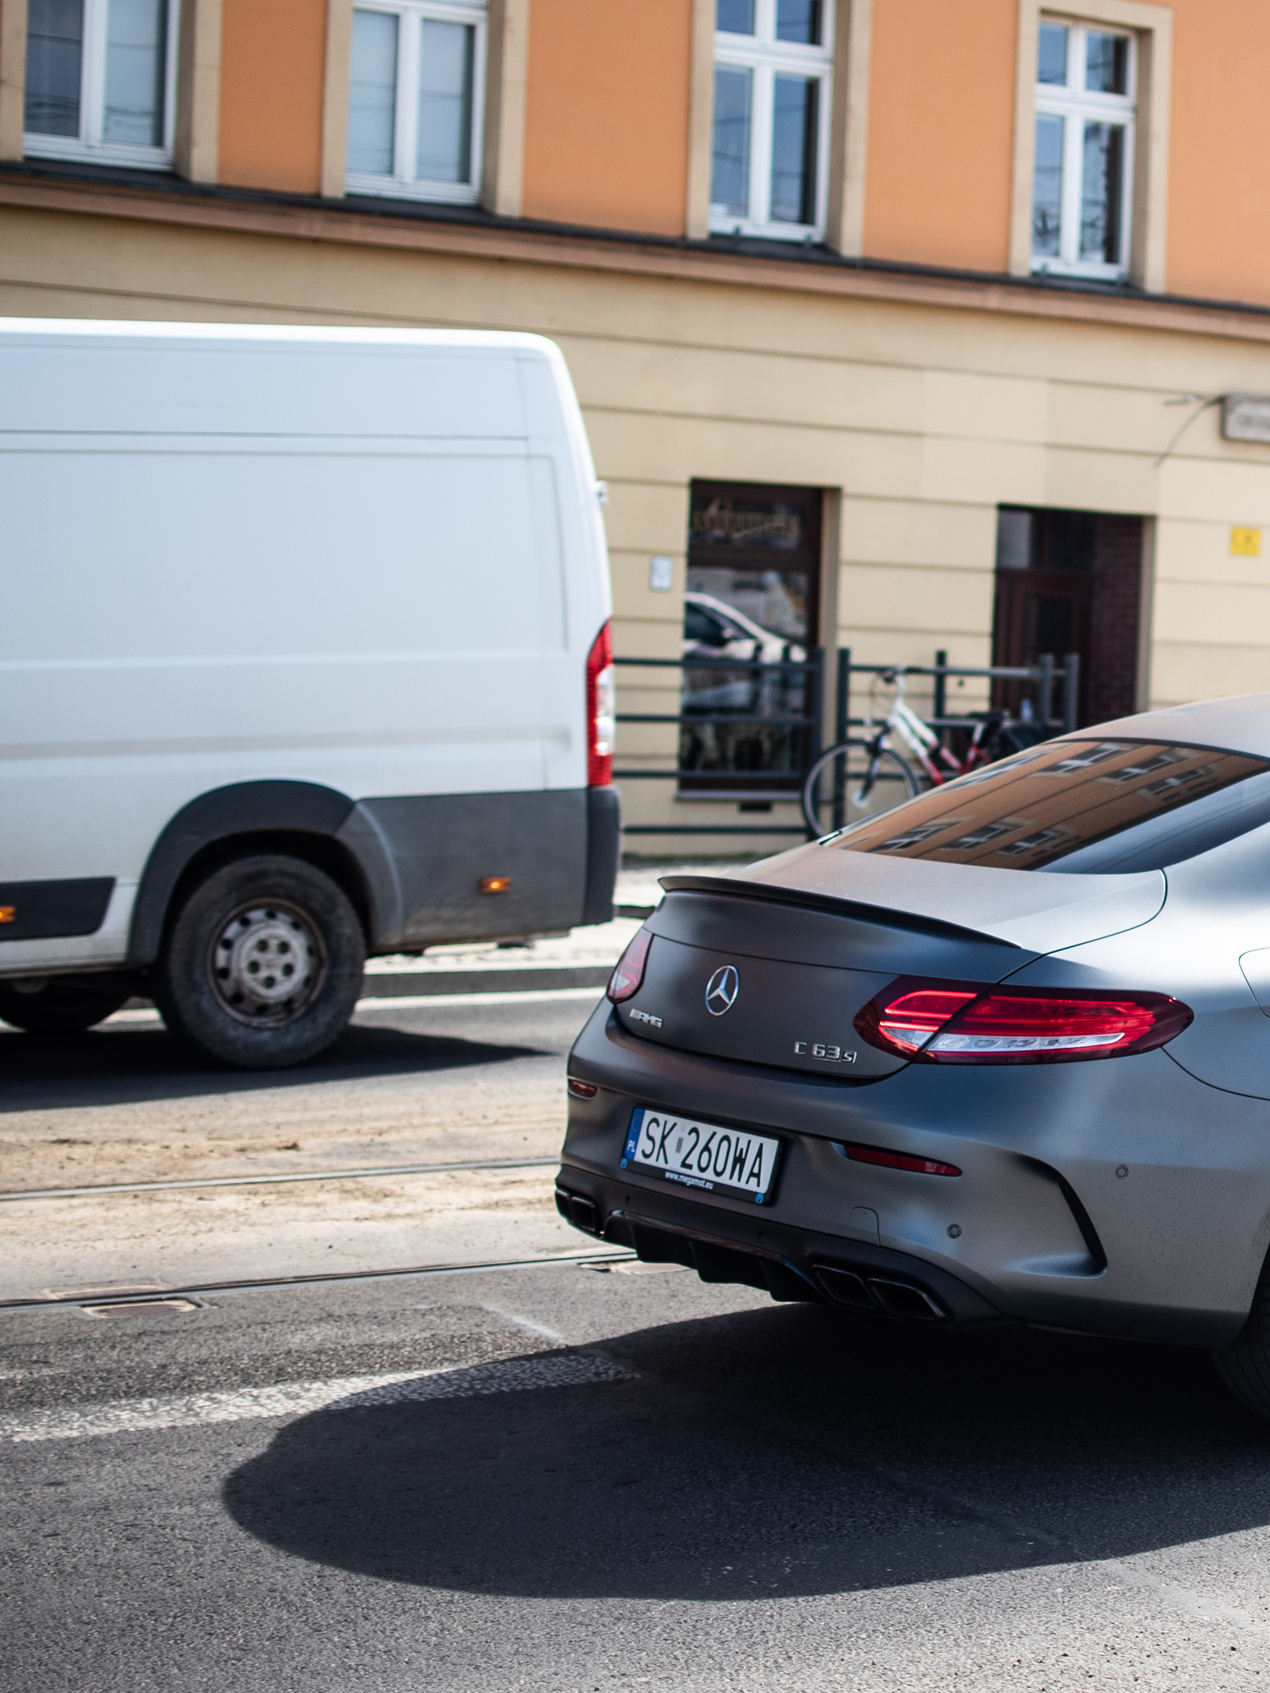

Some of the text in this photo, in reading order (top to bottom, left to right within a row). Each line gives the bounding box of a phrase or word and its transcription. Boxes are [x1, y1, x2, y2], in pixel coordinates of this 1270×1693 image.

[636, 1010, 663, 1028] AMG
[794, 1041, 807, 1055] C
[626, 1139, 636, 1153] PL
[641, 1117, 764, 1188] SK 260WA
[665, 1171, 714, 1189] www.megamot.eu
